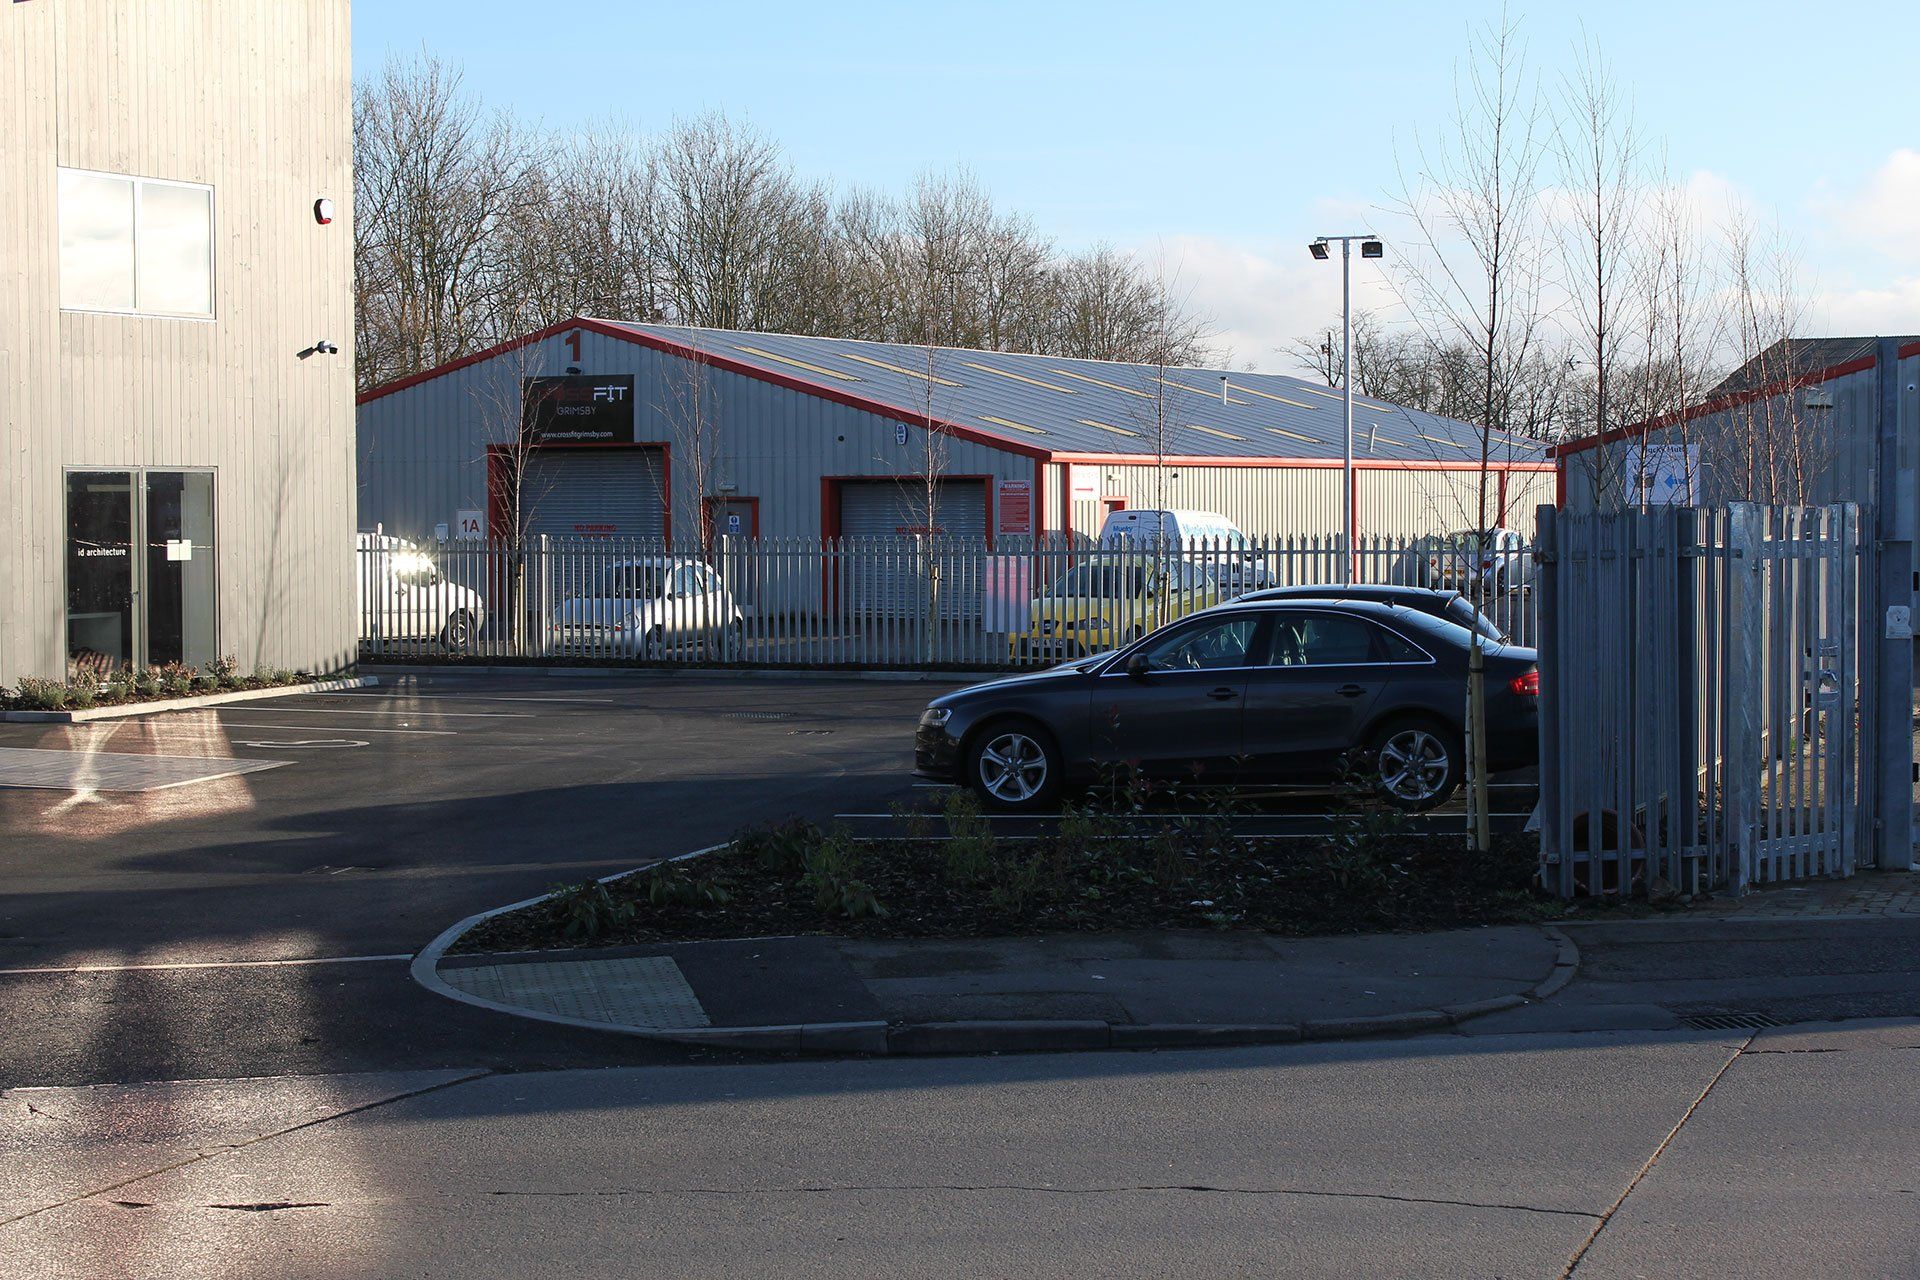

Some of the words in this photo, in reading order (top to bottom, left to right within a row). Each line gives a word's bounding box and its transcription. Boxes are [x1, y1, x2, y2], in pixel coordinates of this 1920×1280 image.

[565, 330, 581, 361] 1
[541, 430, 613, 439] www.crossfitgrimsby.com
[462, 519, 480, 533] 1A
[77, 548, 84, 556] id
[86, 548, 126, 556] architecture
